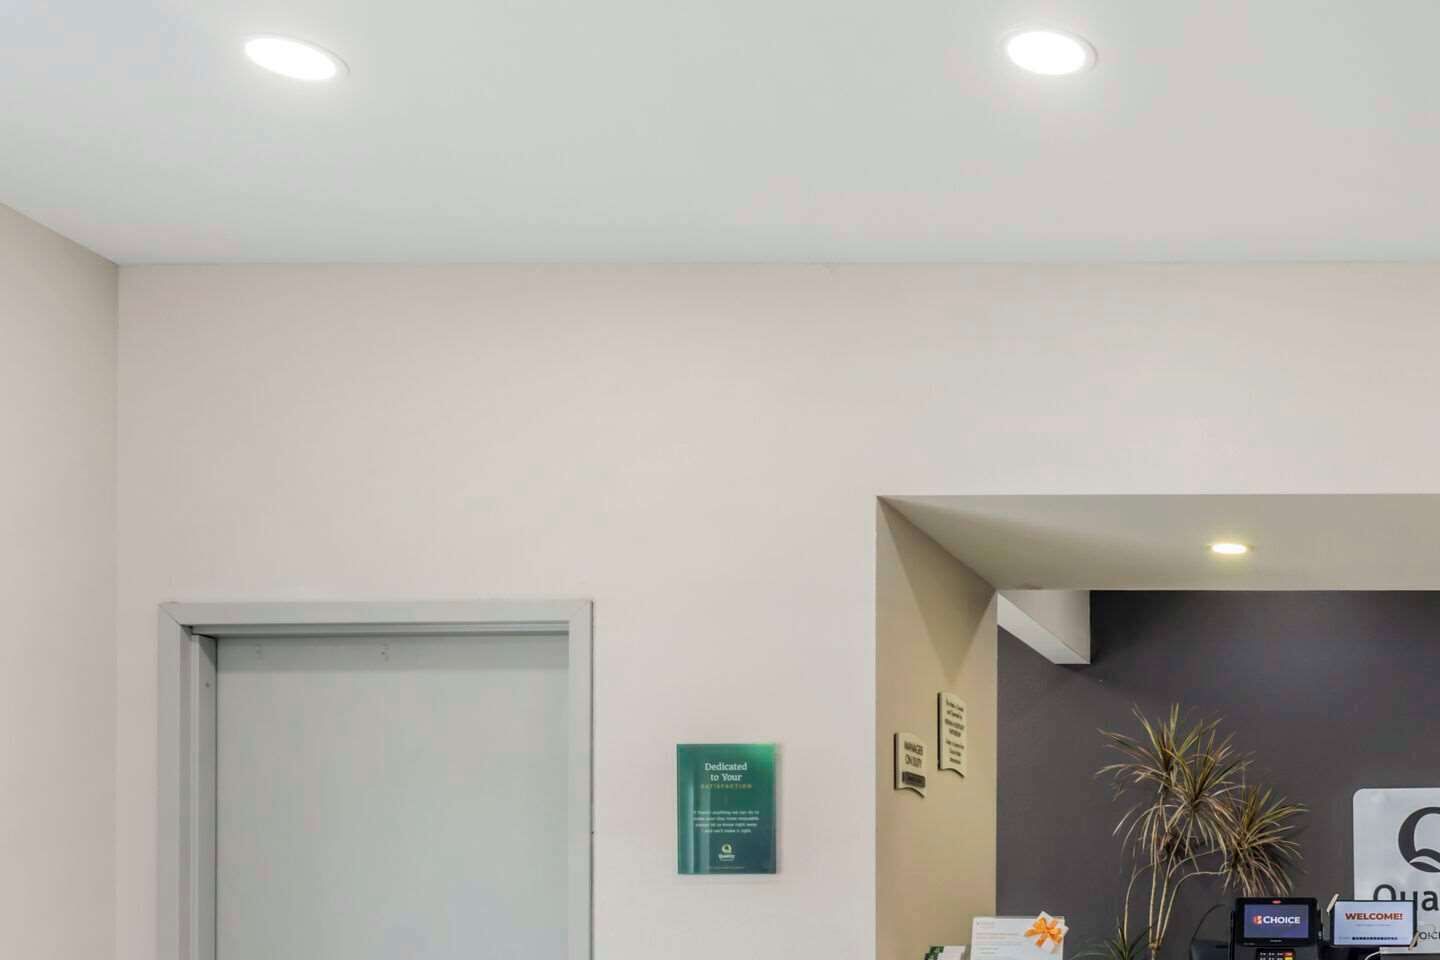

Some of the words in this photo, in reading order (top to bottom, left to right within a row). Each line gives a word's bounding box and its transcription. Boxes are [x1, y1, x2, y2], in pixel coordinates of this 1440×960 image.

[704, 762, 748, 771] Dedicated
[721, 773, 743, 782] Your
[1263, 916, 1301, 924] CHOICE
[1345, 912, 1403, 921] WELCOME!
